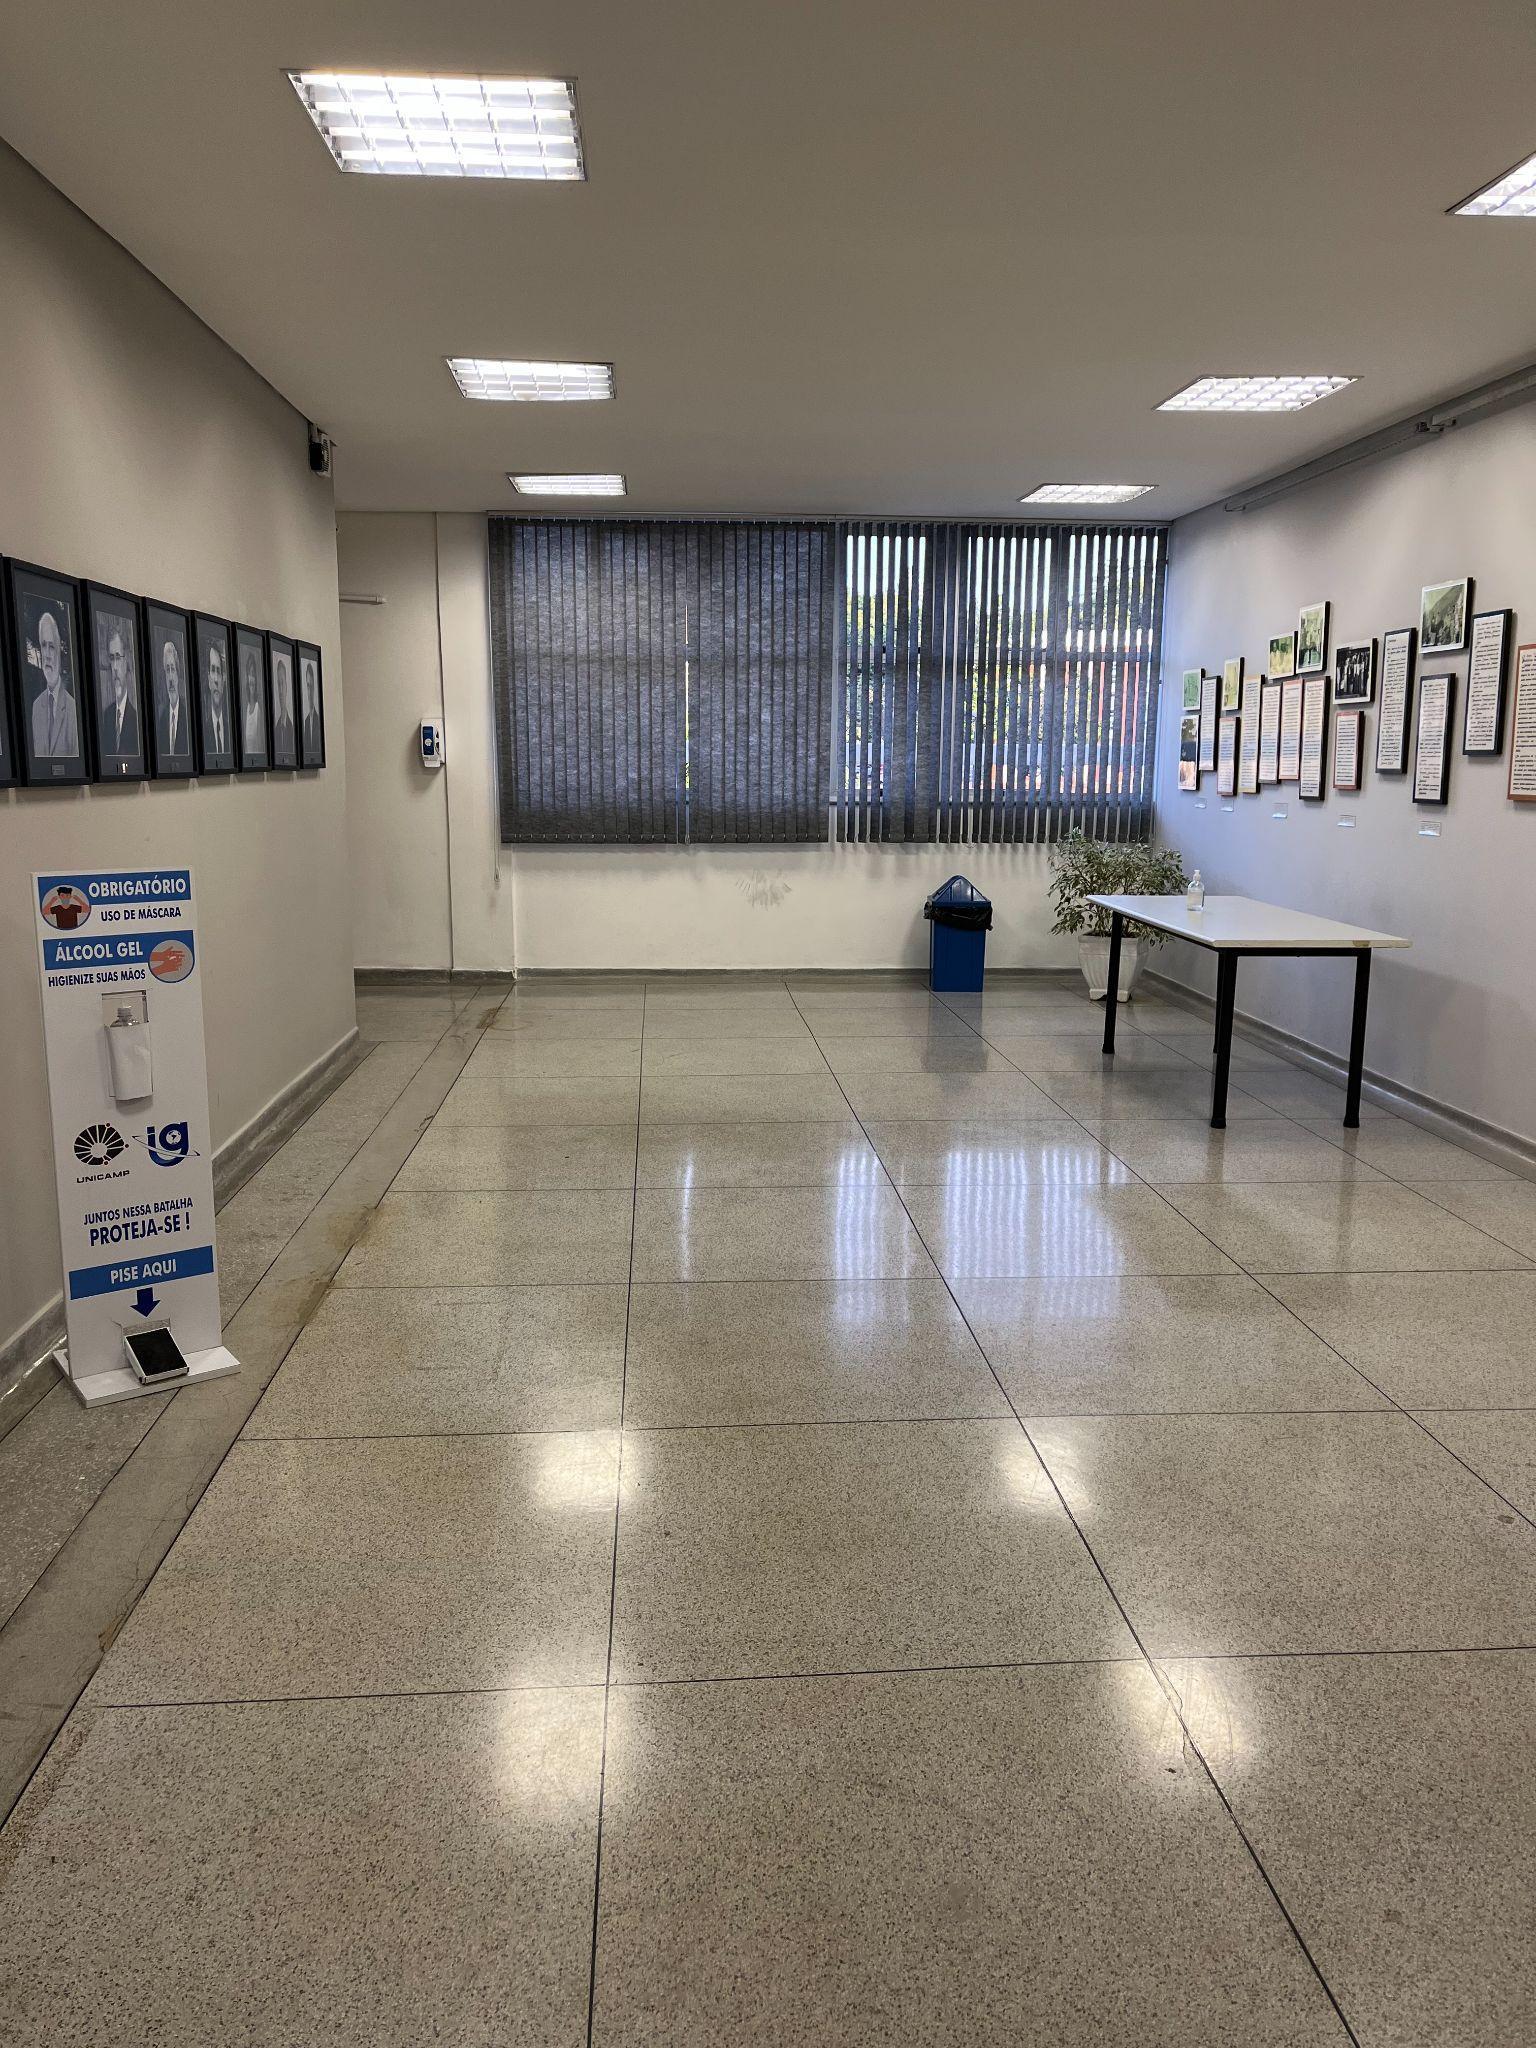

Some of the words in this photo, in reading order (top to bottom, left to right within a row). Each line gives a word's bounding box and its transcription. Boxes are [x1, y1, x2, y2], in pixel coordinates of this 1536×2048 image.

[88, 875, 186, 898] OBRIGATÓRIO
[101, 910, 121, 922] USO
[123, 909, 136, 920] DE
[138, 905, 181, 919] MÁSCARA
[55, 942, 114, 962] ÁLCOOL
[116, 942, 143, 958] GEL
[48, 973, 94, 987] HIGIENIZE
[96, 971, 119, 983] SUAS
[120, 968, 146, 982] MÃOS
[76, 1170, 130, 1184] UNICAMP
[83, 1209, 120, 1225] JUNTOS
[122, 1204, 151, 1219] NESSA
[153, 1197, 193, 1213] BATALHA
[90, 1214, 181, 1247] PROTEJA-SE
[185, 1211, 190, 1230] !
[110, 1265, 138, 1285] PISE
[141, 1258, 177, 1280] AQUI
